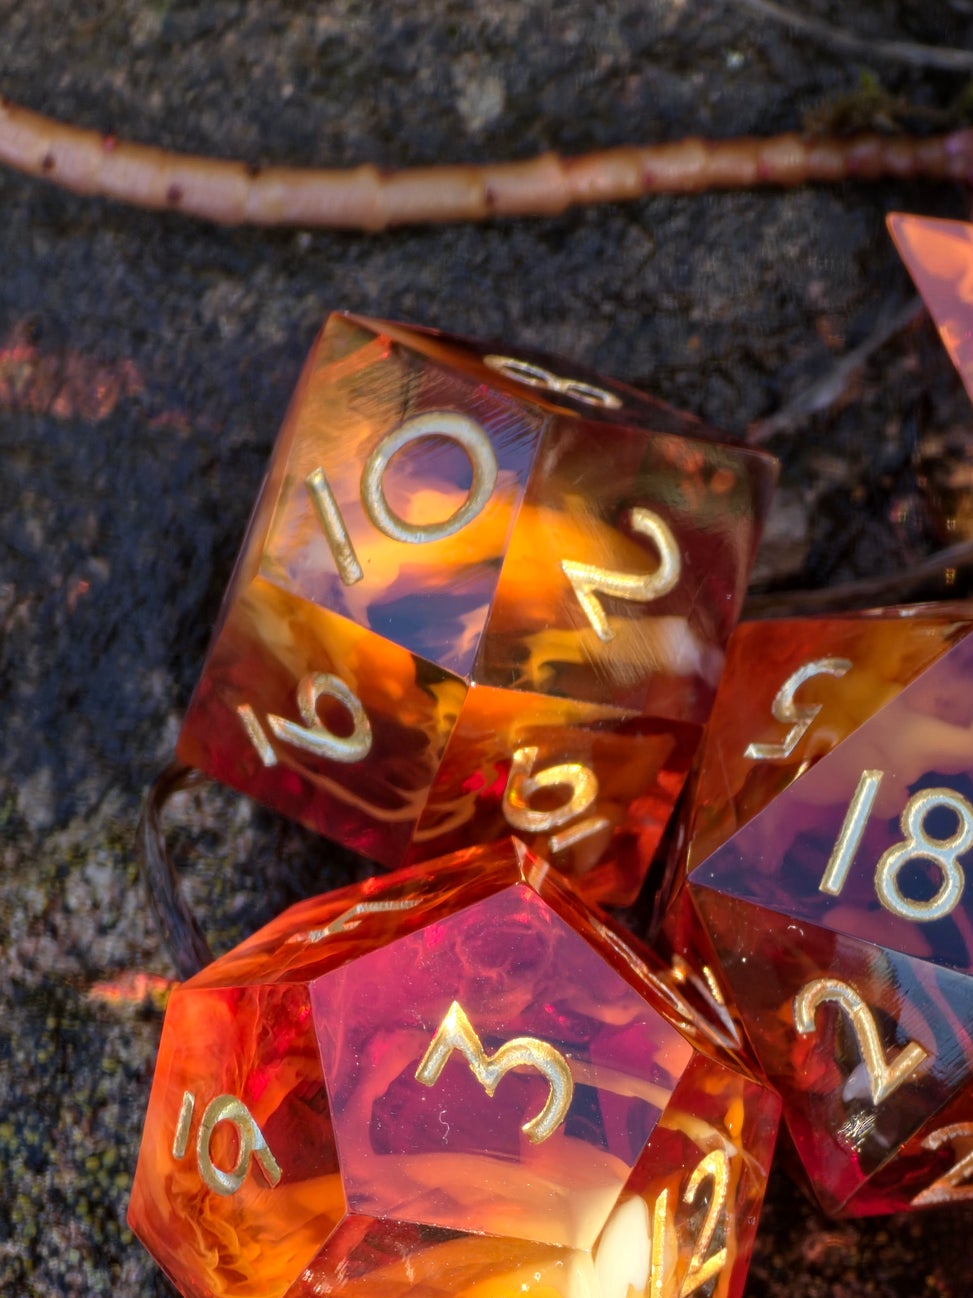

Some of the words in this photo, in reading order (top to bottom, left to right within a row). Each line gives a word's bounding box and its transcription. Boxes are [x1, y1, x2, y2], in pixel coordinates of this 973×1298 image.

[304, 410, 498, 586] 10
[560, 506, 681, 643] 2
[743, 657, 853, 761] 5
[414, 1000, 573, 1145] 3
[793, 976, 934, 1106] 2
